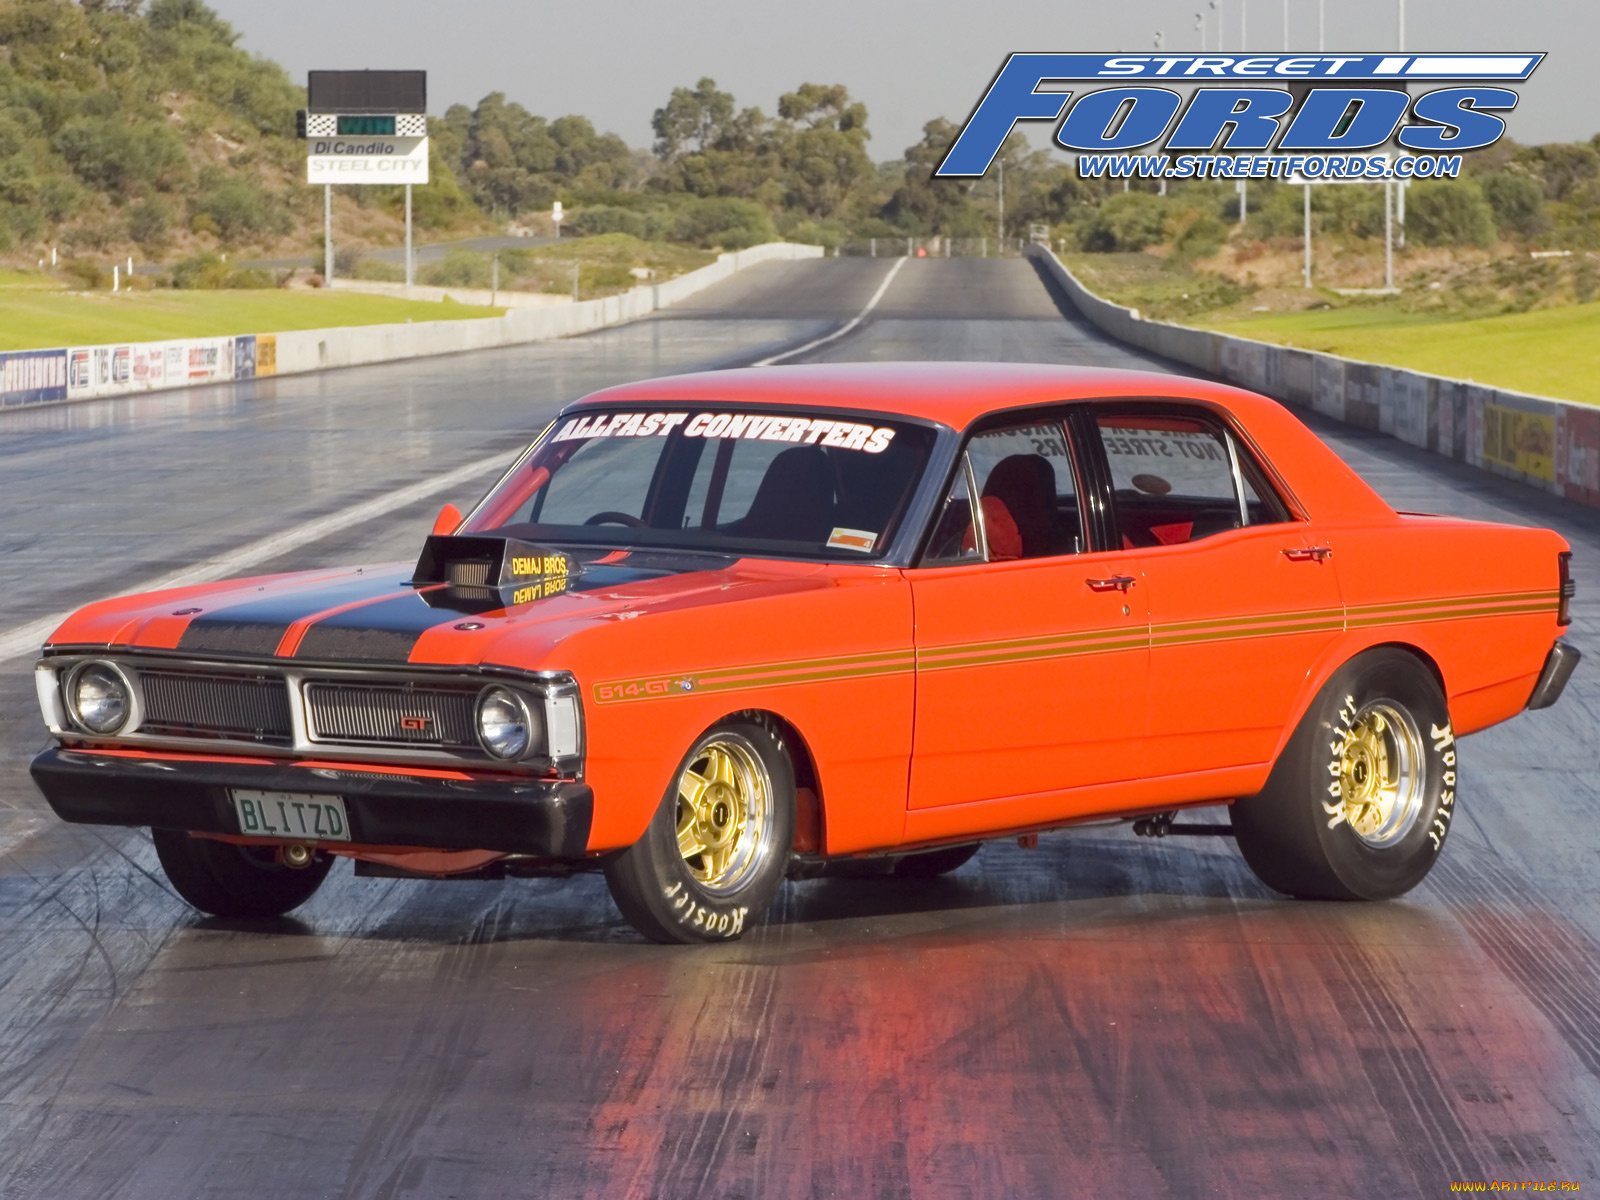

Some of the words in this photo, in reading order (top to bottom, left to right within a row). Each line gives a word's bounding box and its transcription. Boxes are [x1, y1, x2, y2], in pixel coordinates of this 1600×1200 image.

[314, 141, 331, 154] Di
[333, 141, 395, 155] Candilo
[312, 159, 373, 172] STEEL
[377, 159, 423, 172] CITY
[551, 412, 689, 444] ALLFAST
[683, 413, 896, 454] CONVERTERS
[512, 557, 542, 575] DEMAJ
[544, 556, 567, 575] BROS
[599, 679, 671, 700] 514-GT
[401, 716, 433, 730] GT
[240, 799, 343, 836] BLITZD
